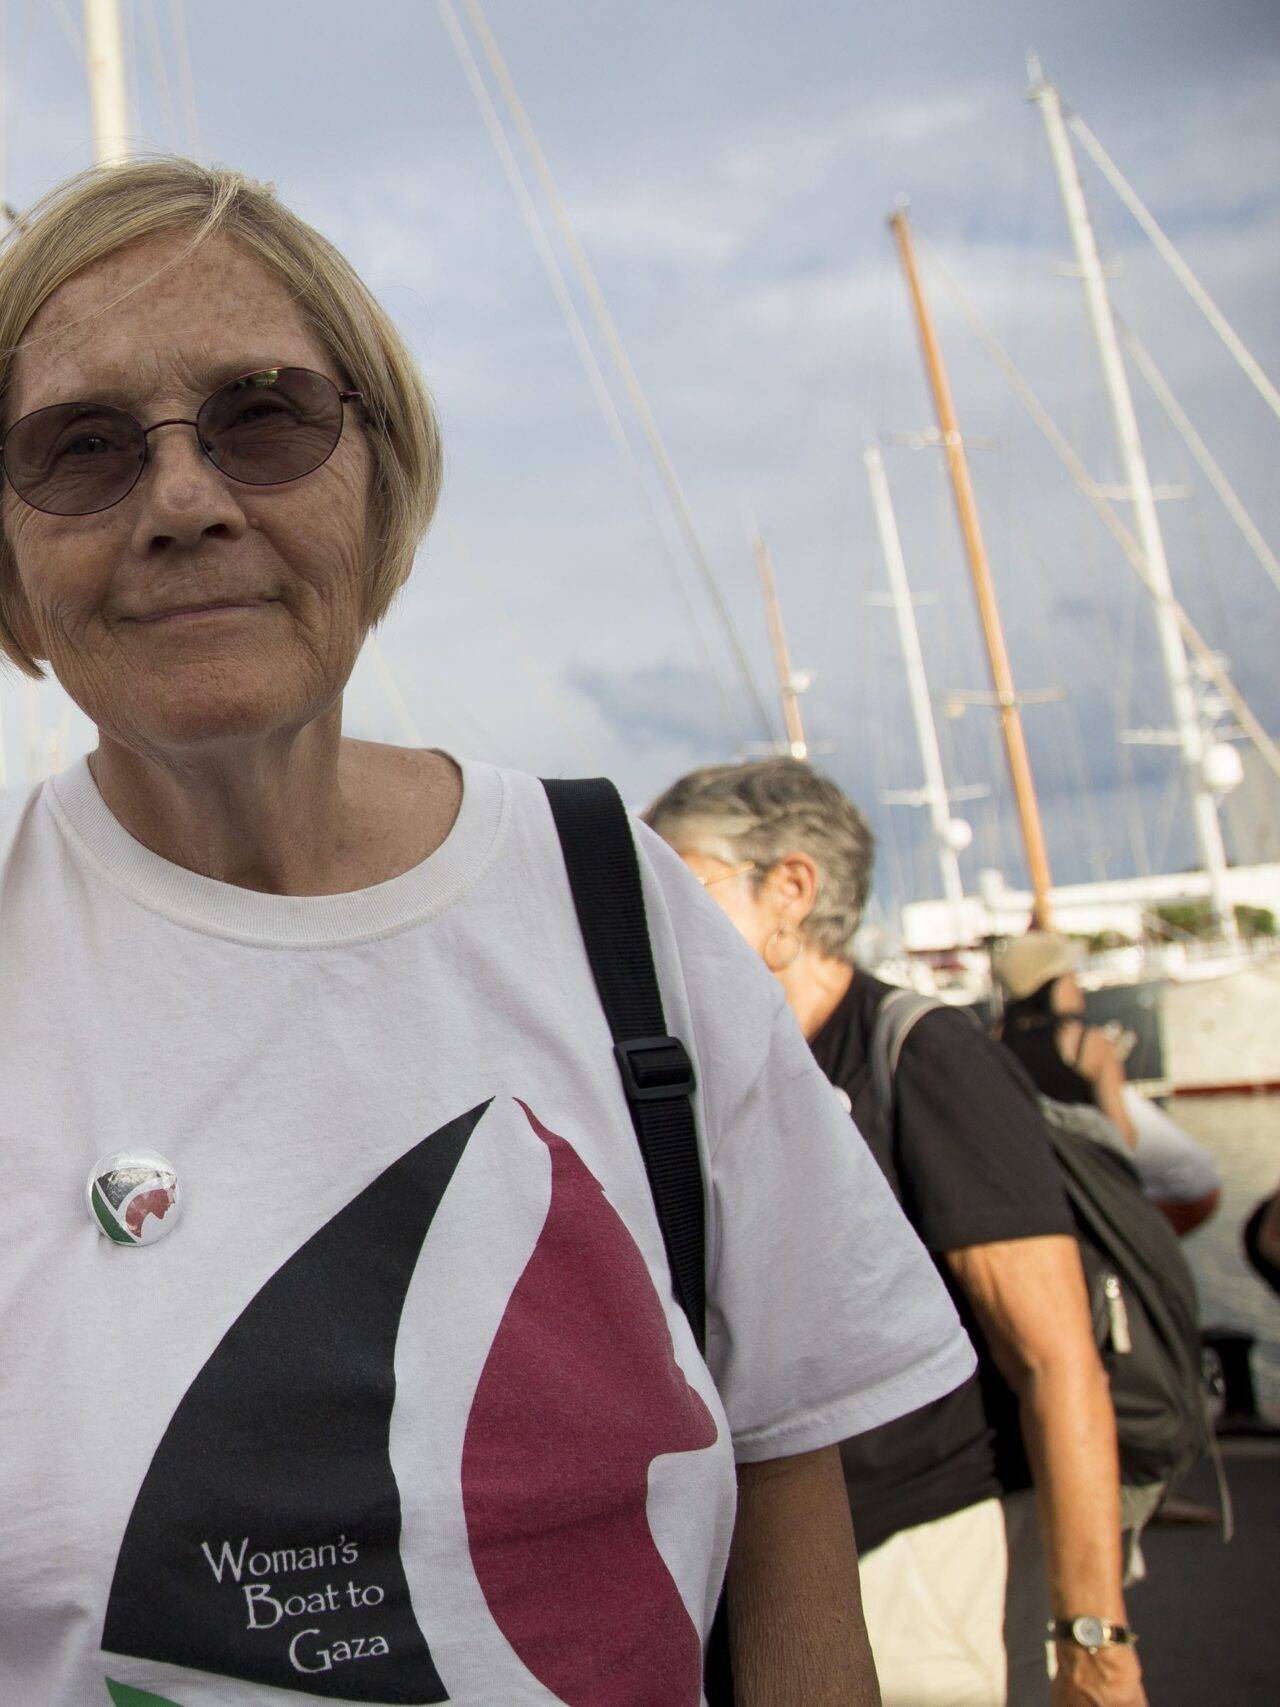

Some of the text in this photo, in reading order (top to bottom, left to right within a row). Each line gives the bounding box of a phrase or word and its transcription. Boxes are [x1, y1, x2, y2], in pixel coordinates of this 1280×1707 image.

[201, 1535, 359, 1583] Woman's
[242, 1581, 385, 1630] Boat to
[288, 1628, 390, 1674] Gaza
